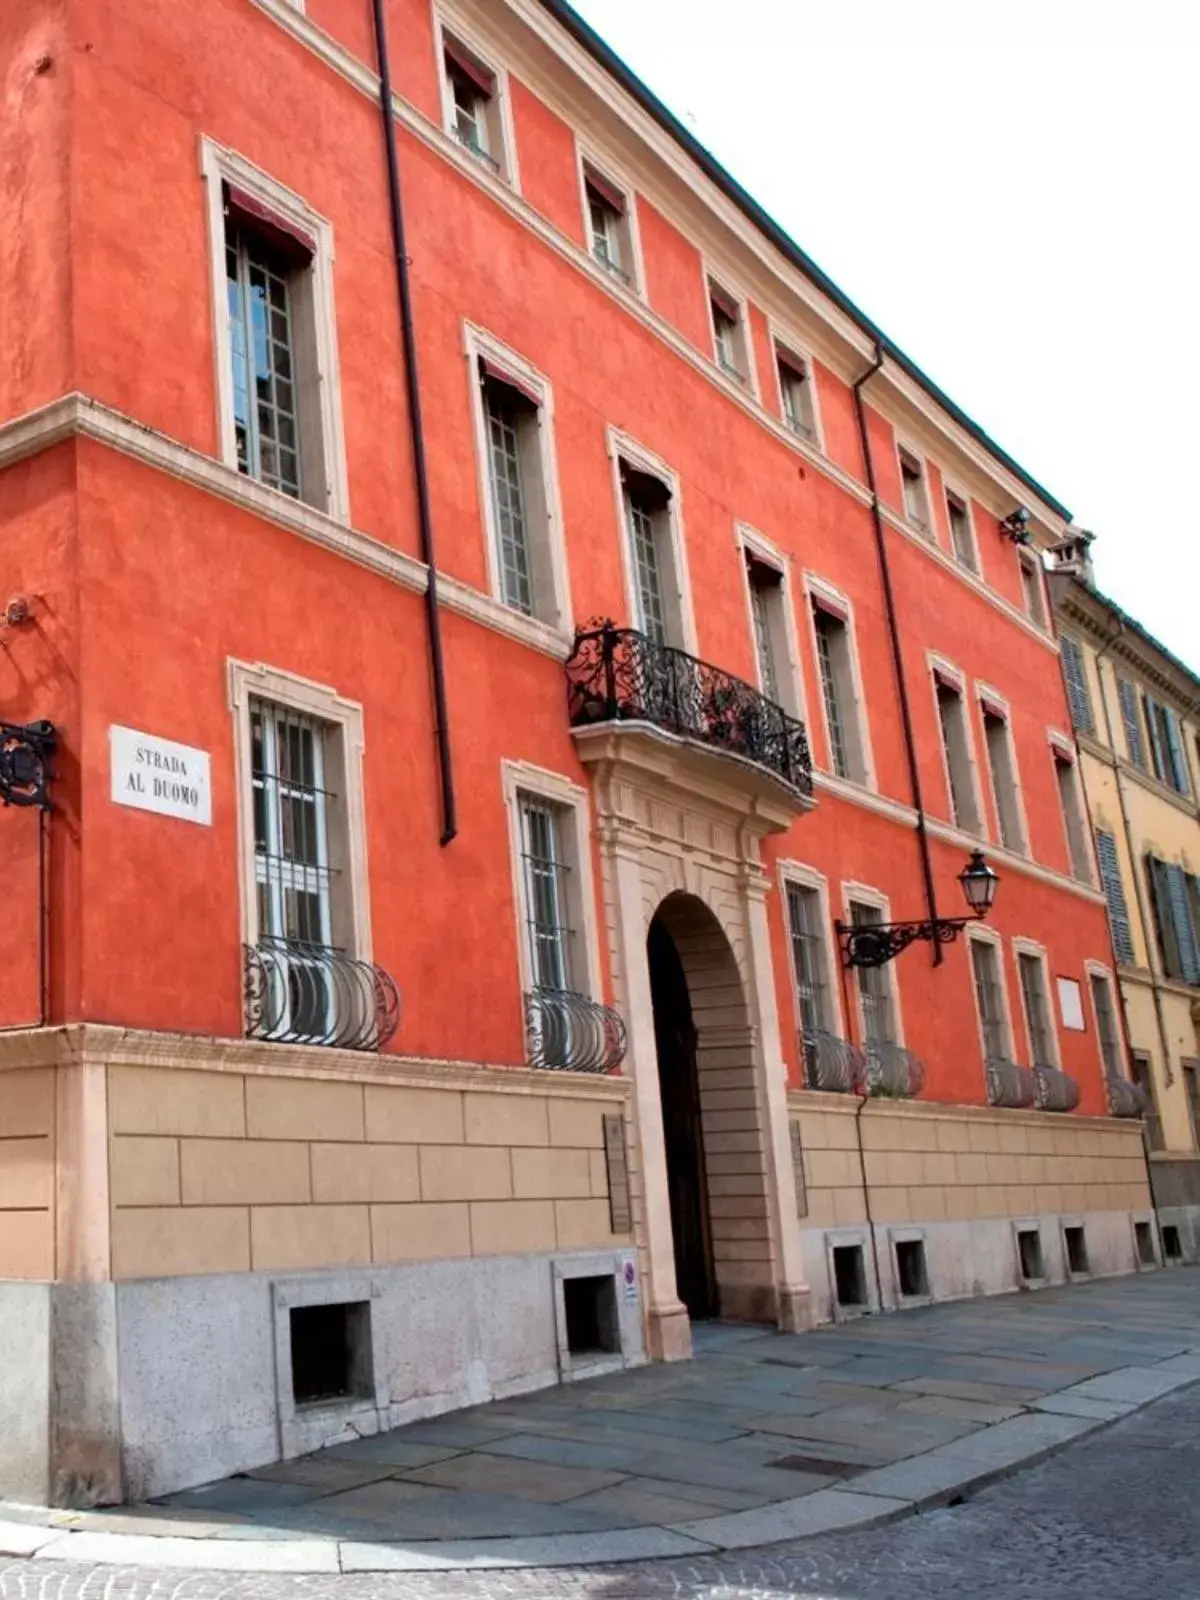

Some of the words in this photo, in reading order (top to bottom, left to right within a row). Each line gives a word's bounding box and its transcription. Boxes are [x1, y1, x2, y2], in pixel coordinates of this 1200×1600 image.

[135, 746, 188, 776] STRADA
[125, 772, 145, 793] AL
[153, 777, 199, 807] DUOMO
